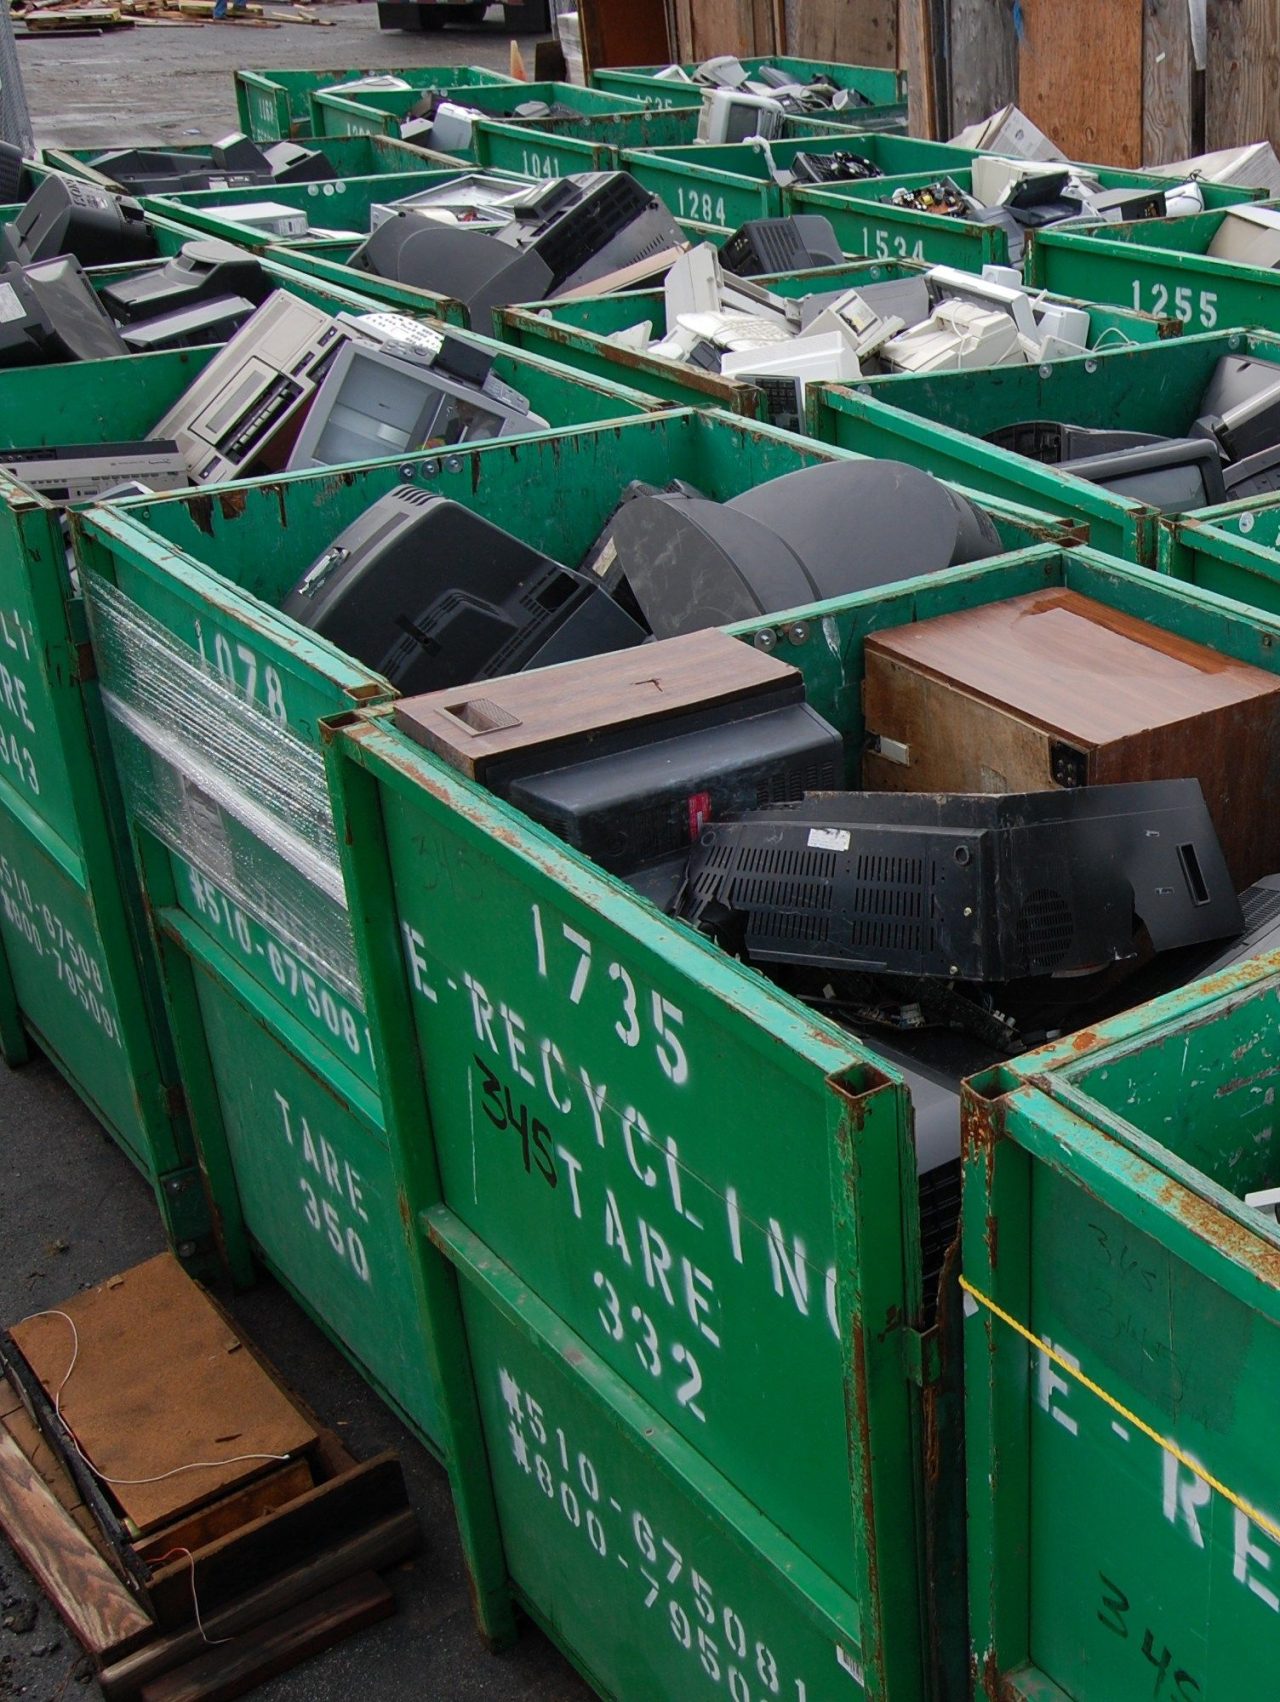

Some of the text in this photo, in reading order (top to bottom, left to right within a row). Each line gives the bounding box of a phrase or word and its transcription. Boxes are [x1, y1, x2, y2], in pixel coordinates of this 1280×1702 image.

[521, 150, 560, 178] 1041
[677, 187, 726, 226] 1284
[1131, 279, 1218, 328] 1255
[194, 619, 288, 731] 1078
[531, 904, 689, 1084] 1735
[274, 1088, 370, 1223] TARE
[300, 1177, 371, 1283] 350
[557, 1144, 722, 1348] TARE
[593, 1271, 706, 1423] 332
[507, 1418, 768, 1702] #800-7950
